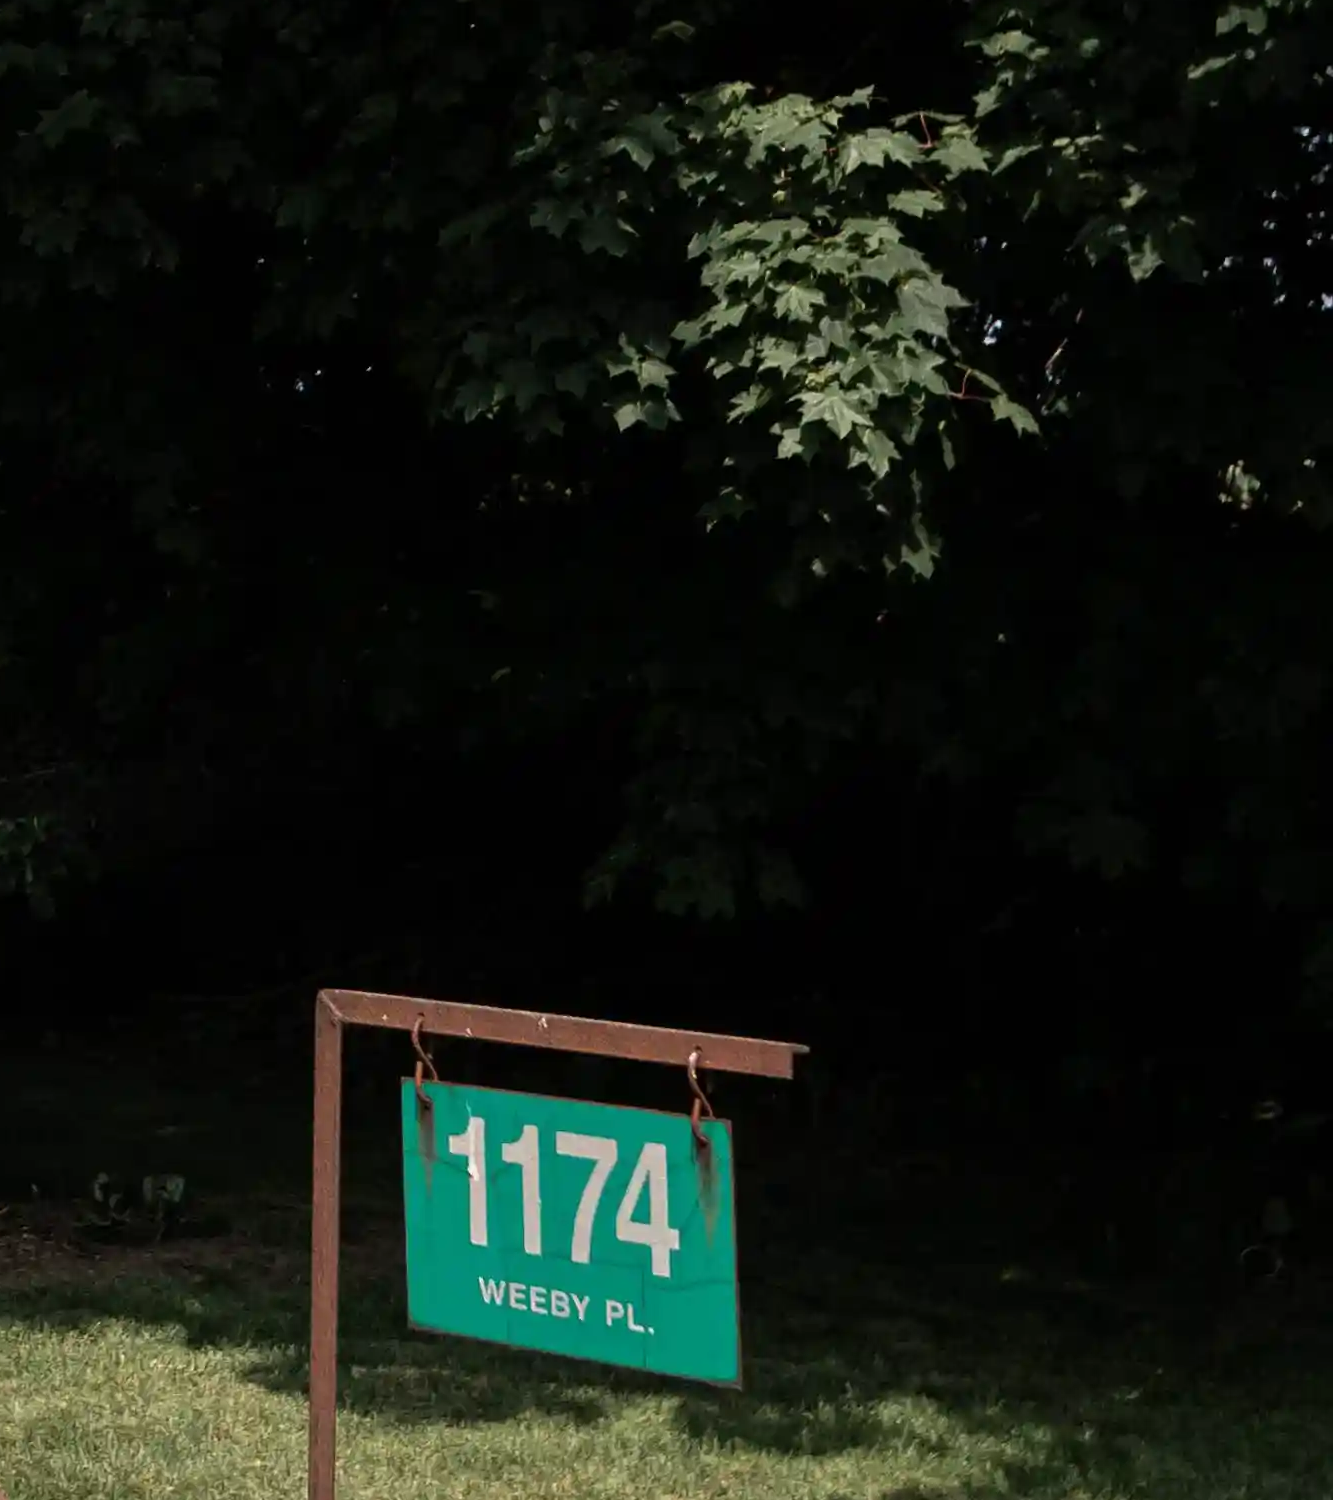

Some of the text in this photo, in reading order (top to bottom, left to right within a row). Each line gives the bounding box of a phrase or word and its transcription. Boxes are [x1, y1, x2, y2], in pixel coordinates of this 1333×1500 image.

[448, 1116, 680, 1278] 1174
[478, 1276, 655, 1335] WEEBY PL.
